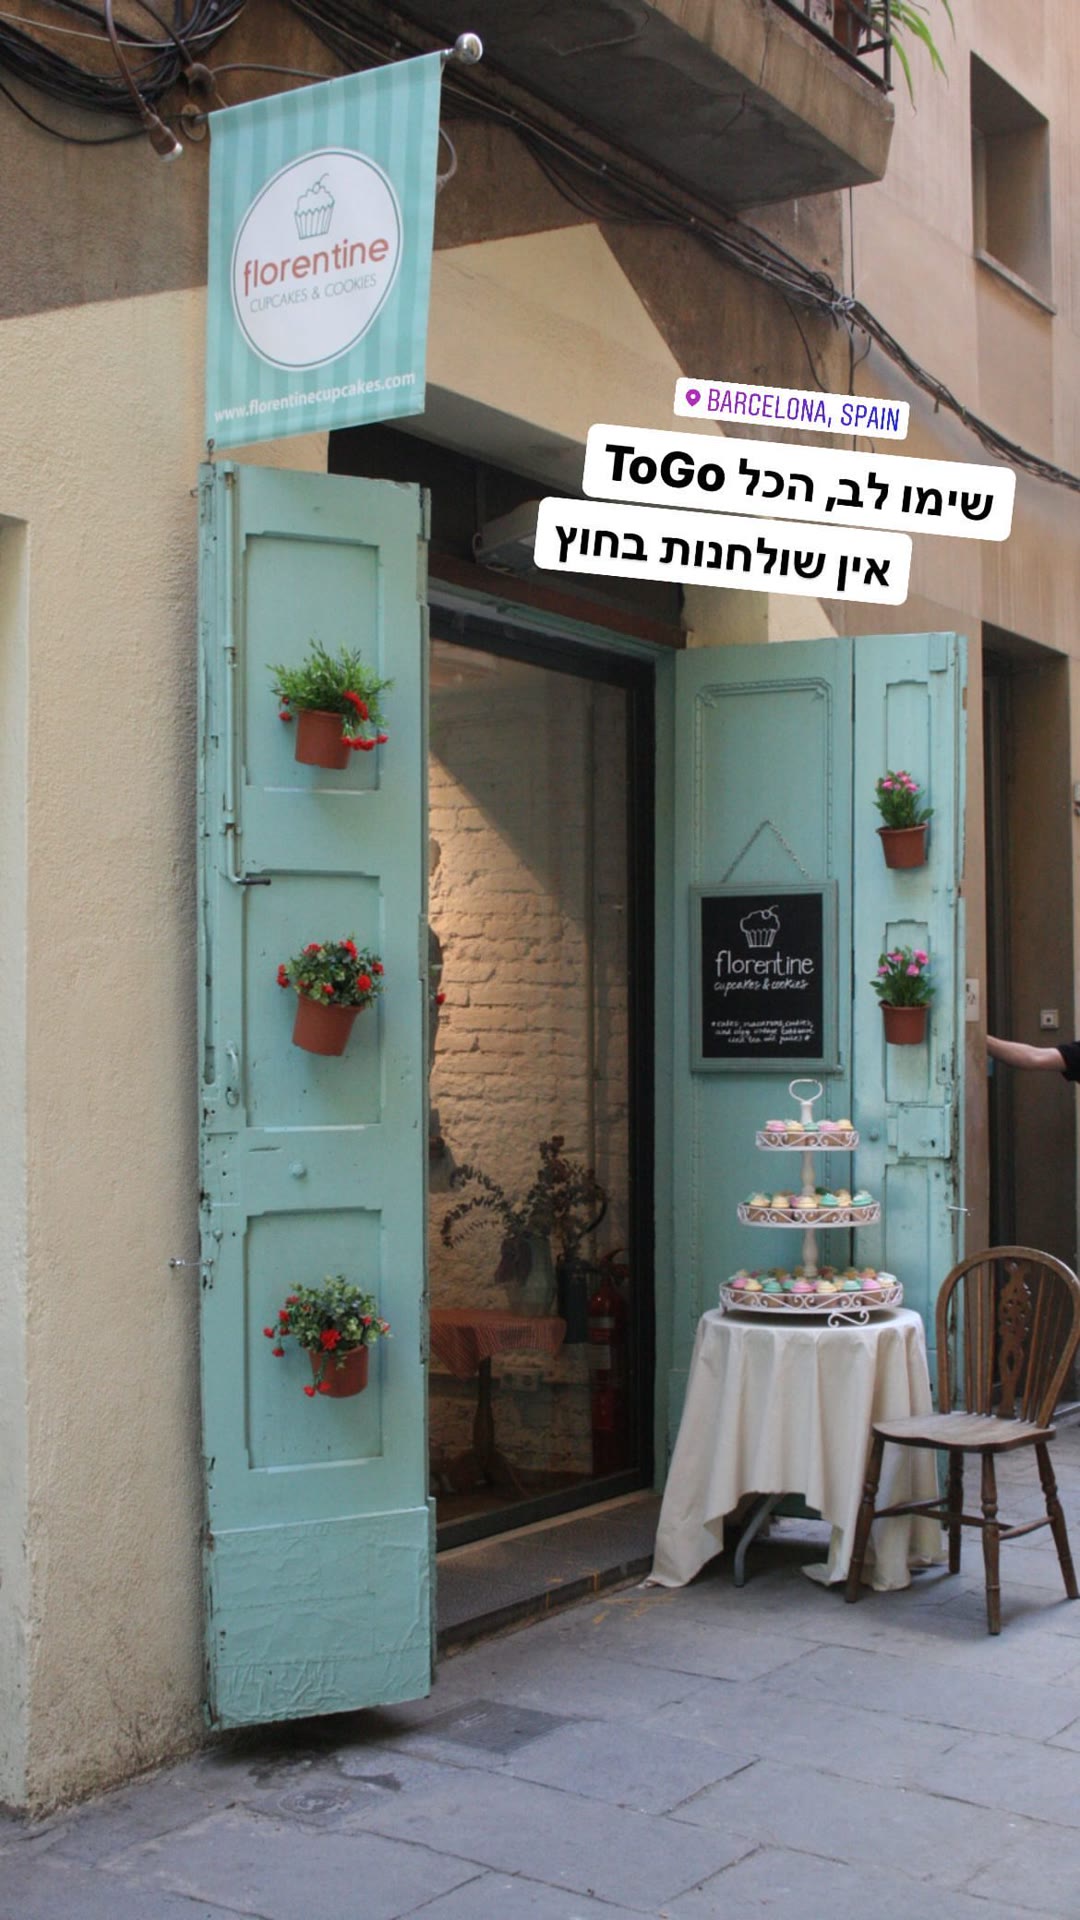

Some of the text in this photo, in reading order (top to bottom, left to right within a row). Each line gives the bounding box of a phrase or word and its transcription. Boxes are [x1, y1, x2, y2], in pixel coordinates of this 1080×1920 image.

[244, 238, 389, 297] florentine
[250, 273, 377, 313] CUPCAKES & COOKIES
[214, 373, 416, 422] www.florentinecupcakes.com
[715, 950, 815, 977] florentine
[714, 978, 809, 997] cupcakes & cookies
